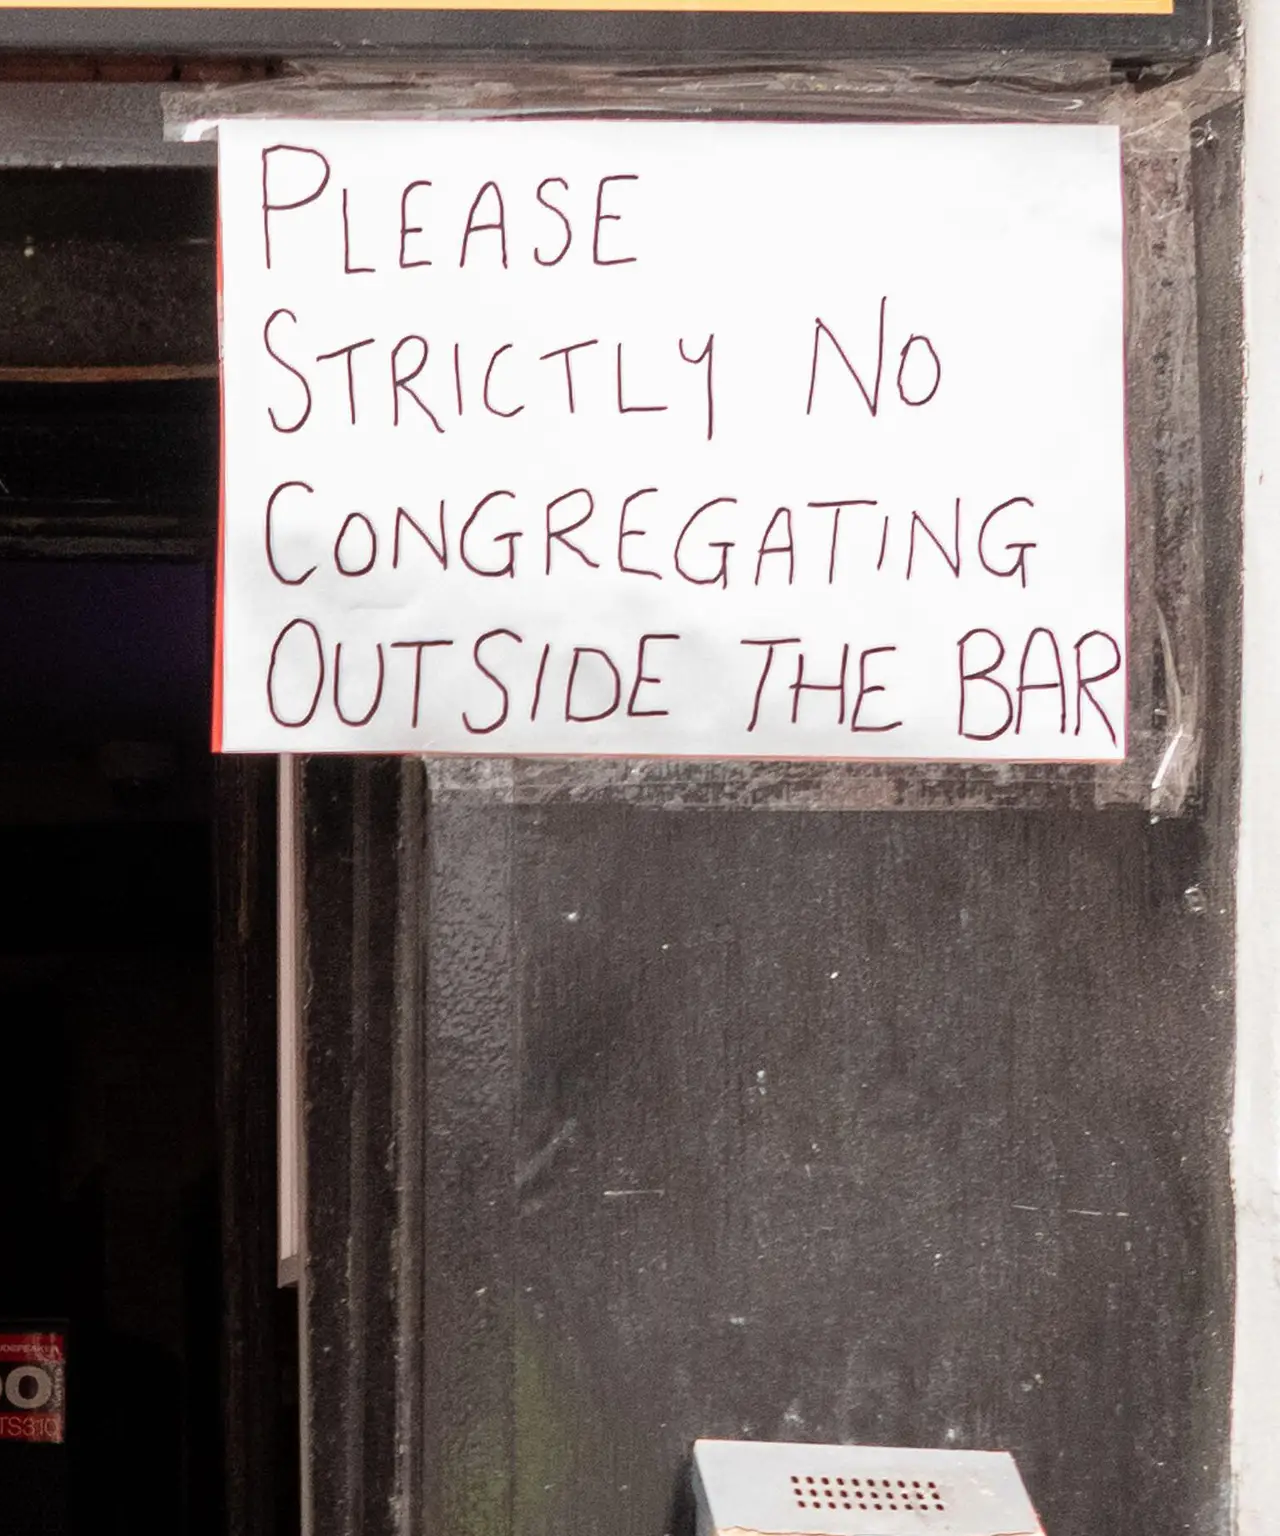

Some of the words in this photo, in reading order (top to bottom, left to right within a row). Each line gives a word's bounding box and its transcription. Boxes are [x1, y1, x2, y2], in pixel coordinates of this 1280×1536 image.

[261, 144, 639, 275] PLEASE
[263, 308, 715, 441] STRICTLY
[806, 295, 941, 417] NO
[265, 480, 1037, 590] CONGREGATING
[266, 617, 681, 735] OUTSIDE
[740, 637, 903, 733] THE
[956, 626, 1122, 745] BAR
